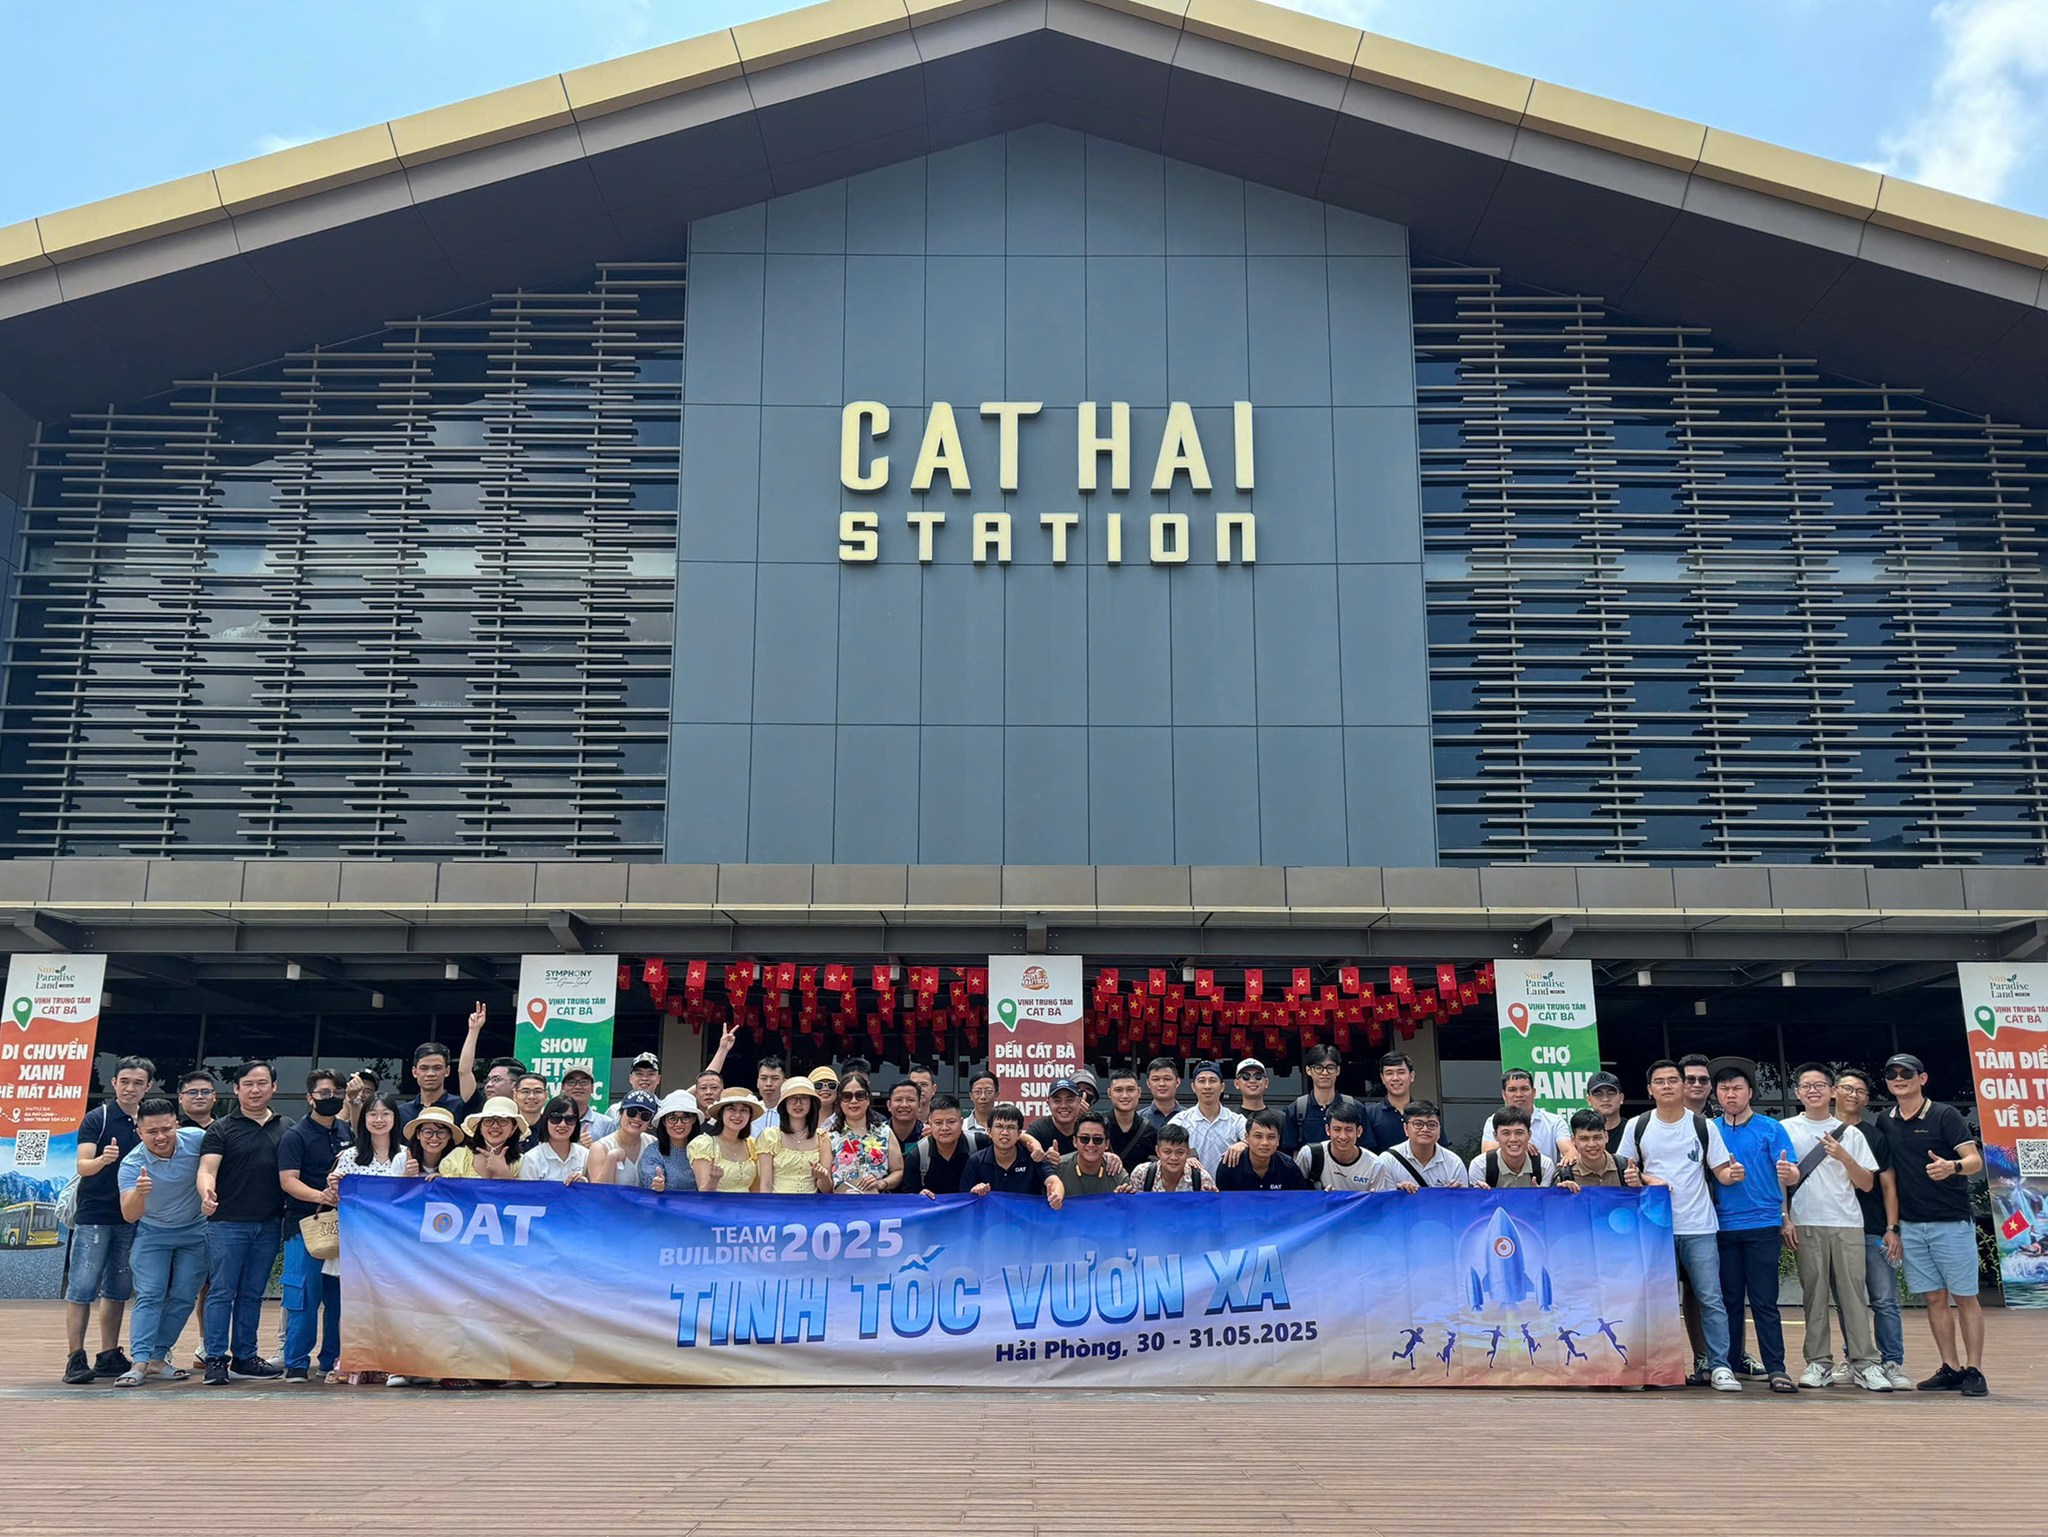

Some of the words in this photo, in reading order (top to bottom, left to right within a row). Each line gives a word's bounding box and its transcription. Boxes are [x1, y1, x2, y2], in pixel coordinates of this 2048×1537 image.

[840, 400, 1043, 493] CAT
[1078, 400, 1254, 493] HAI
[839, 511, 1256, 564] STATION
[36, 973, 76, 981] Paradise
[36, 981, 58, 990] Land
[1525, 978, 1565, 988] Paradise
[1990, 981, 2029, 990] Paradise
[1526, 987, 1549, 996] Land
[1991, 990, 2014, 998] Land
[1035, 998, 1058, 1006] TRUNG
[2012, 1005, 2036, 1013] TRUNG
[1, 1044, 19, 1060] DI
[23, 1037, 88, 1060] CHUYỂN
[540, 1038, 588, 1053] SHOW
[995, 1040, 1022, 1058] ĐẾN
[1026, 1041, 1052, 1058] CÁT
[1055, 1041, 1076, 1058] BÀ
[1531, 1044, 1571, 1066] CHỢ
[1974, 1047, 2015, 1069] TÂM
[2019, 1044, 2048, 1069] ĐIỂ
[18, 1064, 65, 1080] XANH
[995, 1060, 1030, 1078] PHẢI
[17, 1083, 45, 1099] MÁT
[47, 1083, 82, 1099] LÀNH
[1020, 1082, 1051, 1098] SUN
[1532, 1071, 1593, 1100] ANH
[1980, 1072, 2028, 1100] GIẢI
[1994, 1103, 2020, 1127] VỀ
[1353, 1175, 1369, 1183] DAT
[419, 1201, 547, 1247] DAT
[658, 1246, 778, 1267] BUILDING
[779, 1218, 905, 1261] 2025
[711, 1225, 777, 1244] TEAM
[850, 1243, 981, 1339] TỐC
[1002, 1247, 1185, 1330] VƯƠN
[1204, 1244, 1291, 1316] XA
[995, 1340, 1037, 1362] Hải
[1044, 1337, 1129, 1361] Phòng,
[1136, 1331, 1165, 1354] 30
[1189, 1320, 1319, 1349] 31.05.2025
